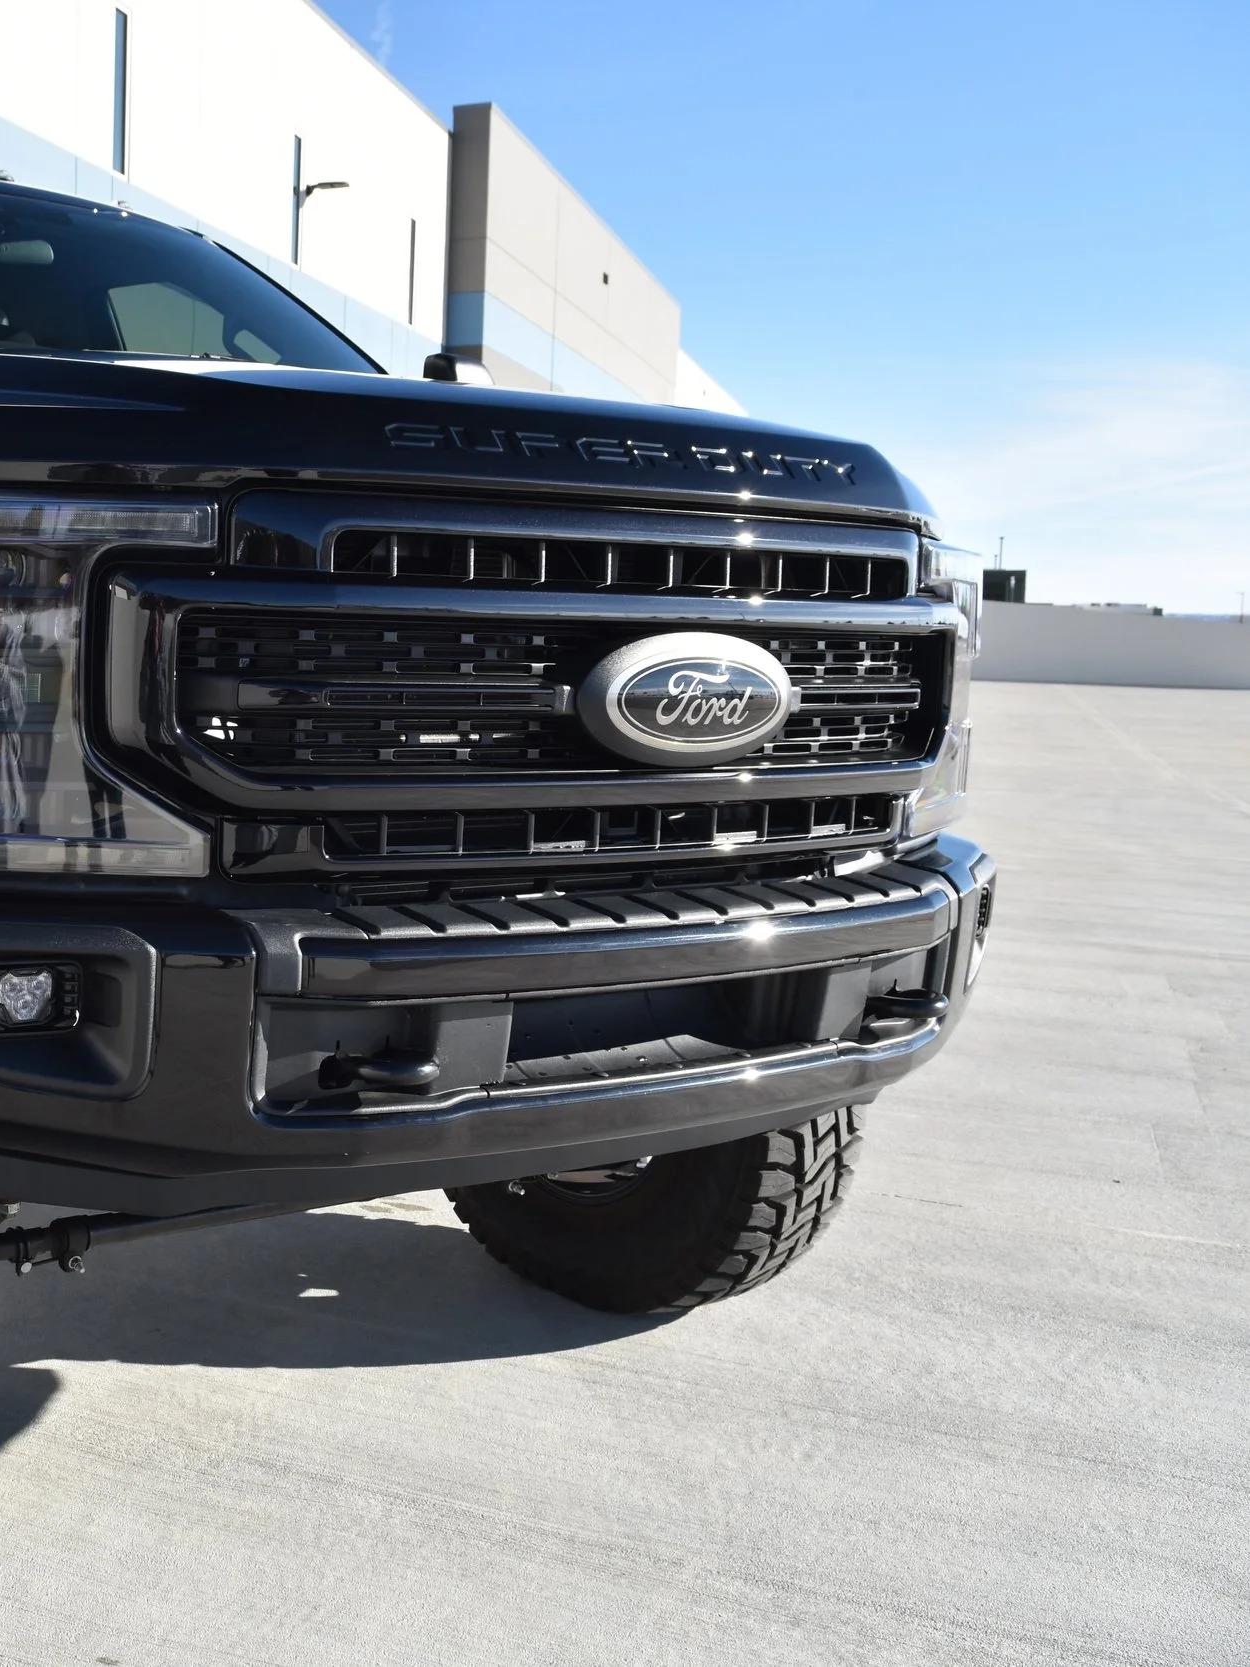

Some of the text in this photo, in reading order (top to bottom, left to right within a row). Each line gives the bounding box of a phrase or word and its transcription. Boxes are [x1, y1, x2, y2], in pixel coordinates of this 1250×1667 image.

[383, 422, 856, 486] SUPER DUTY
[656, 670, 753, 726] Ford
